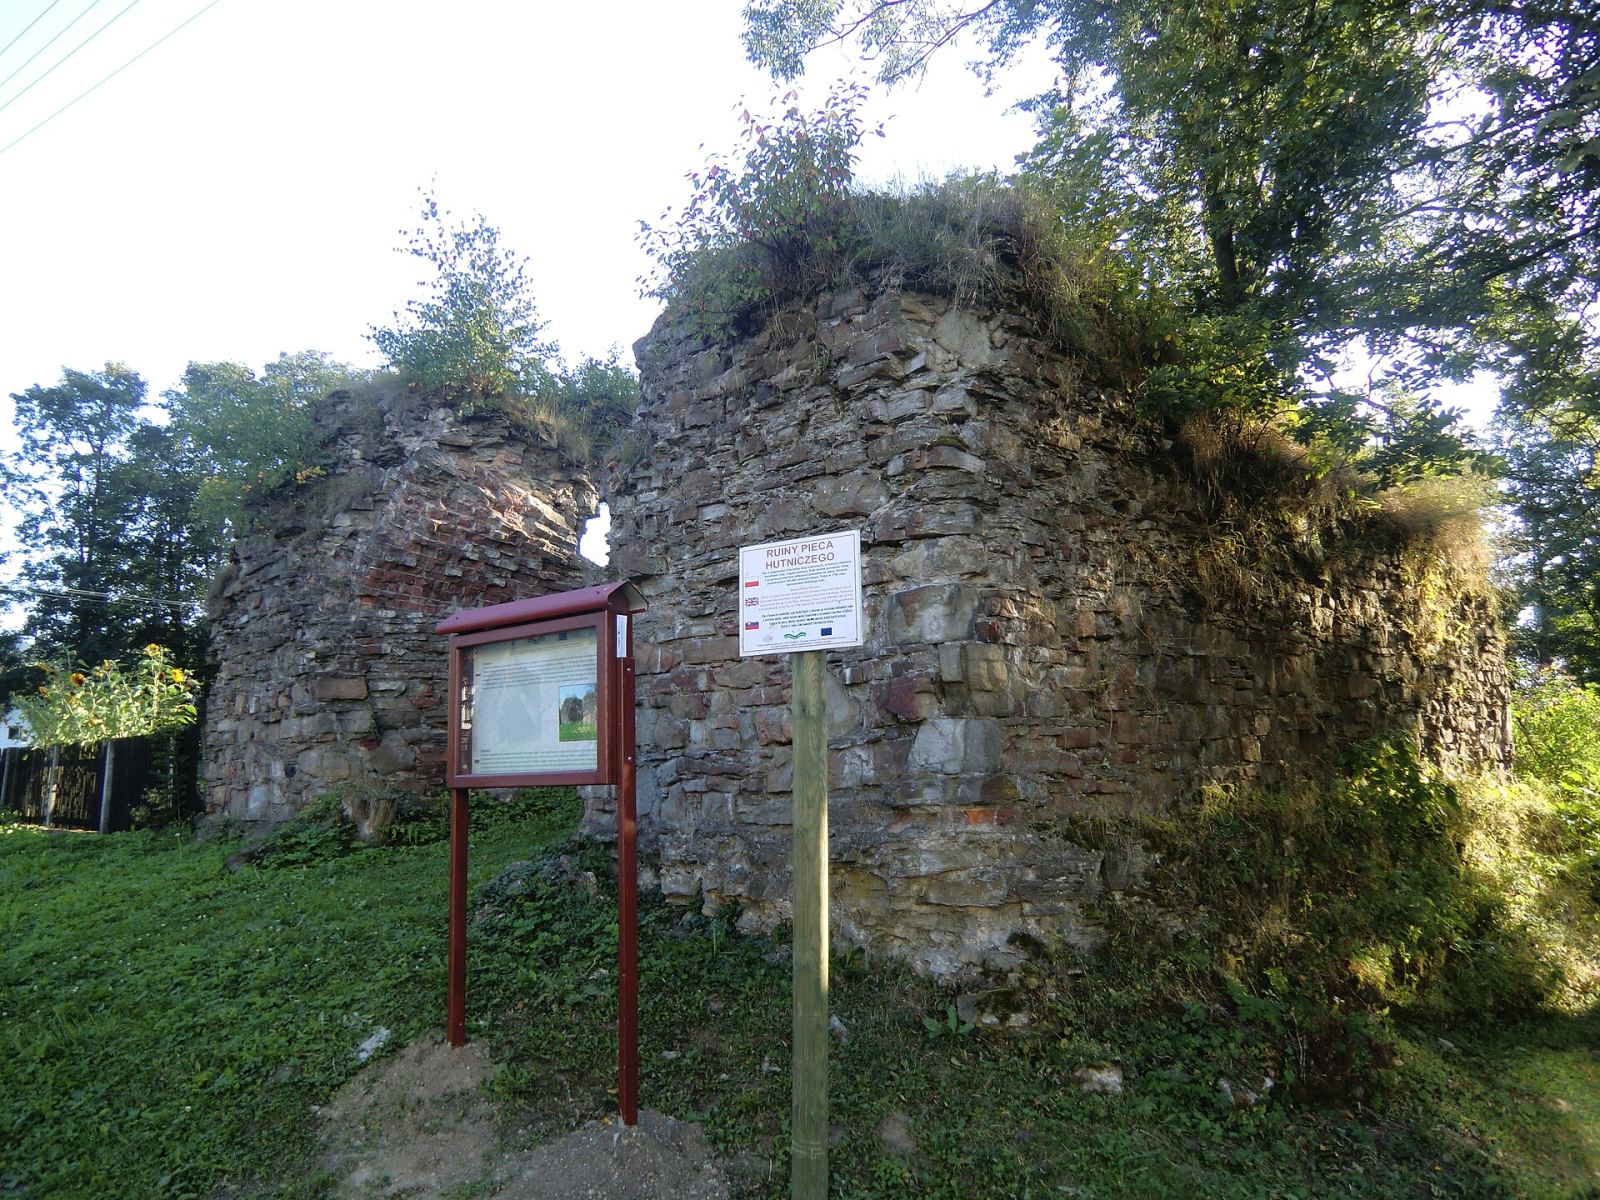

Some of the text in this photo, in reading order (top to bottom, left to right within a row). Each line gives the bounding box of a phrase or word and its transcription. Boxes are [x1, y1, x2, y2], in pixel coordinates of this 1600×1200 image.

[766, 540, 834, 558] RUINY PIECA
[765, 552, 835, 570] HUTNICZEGO
